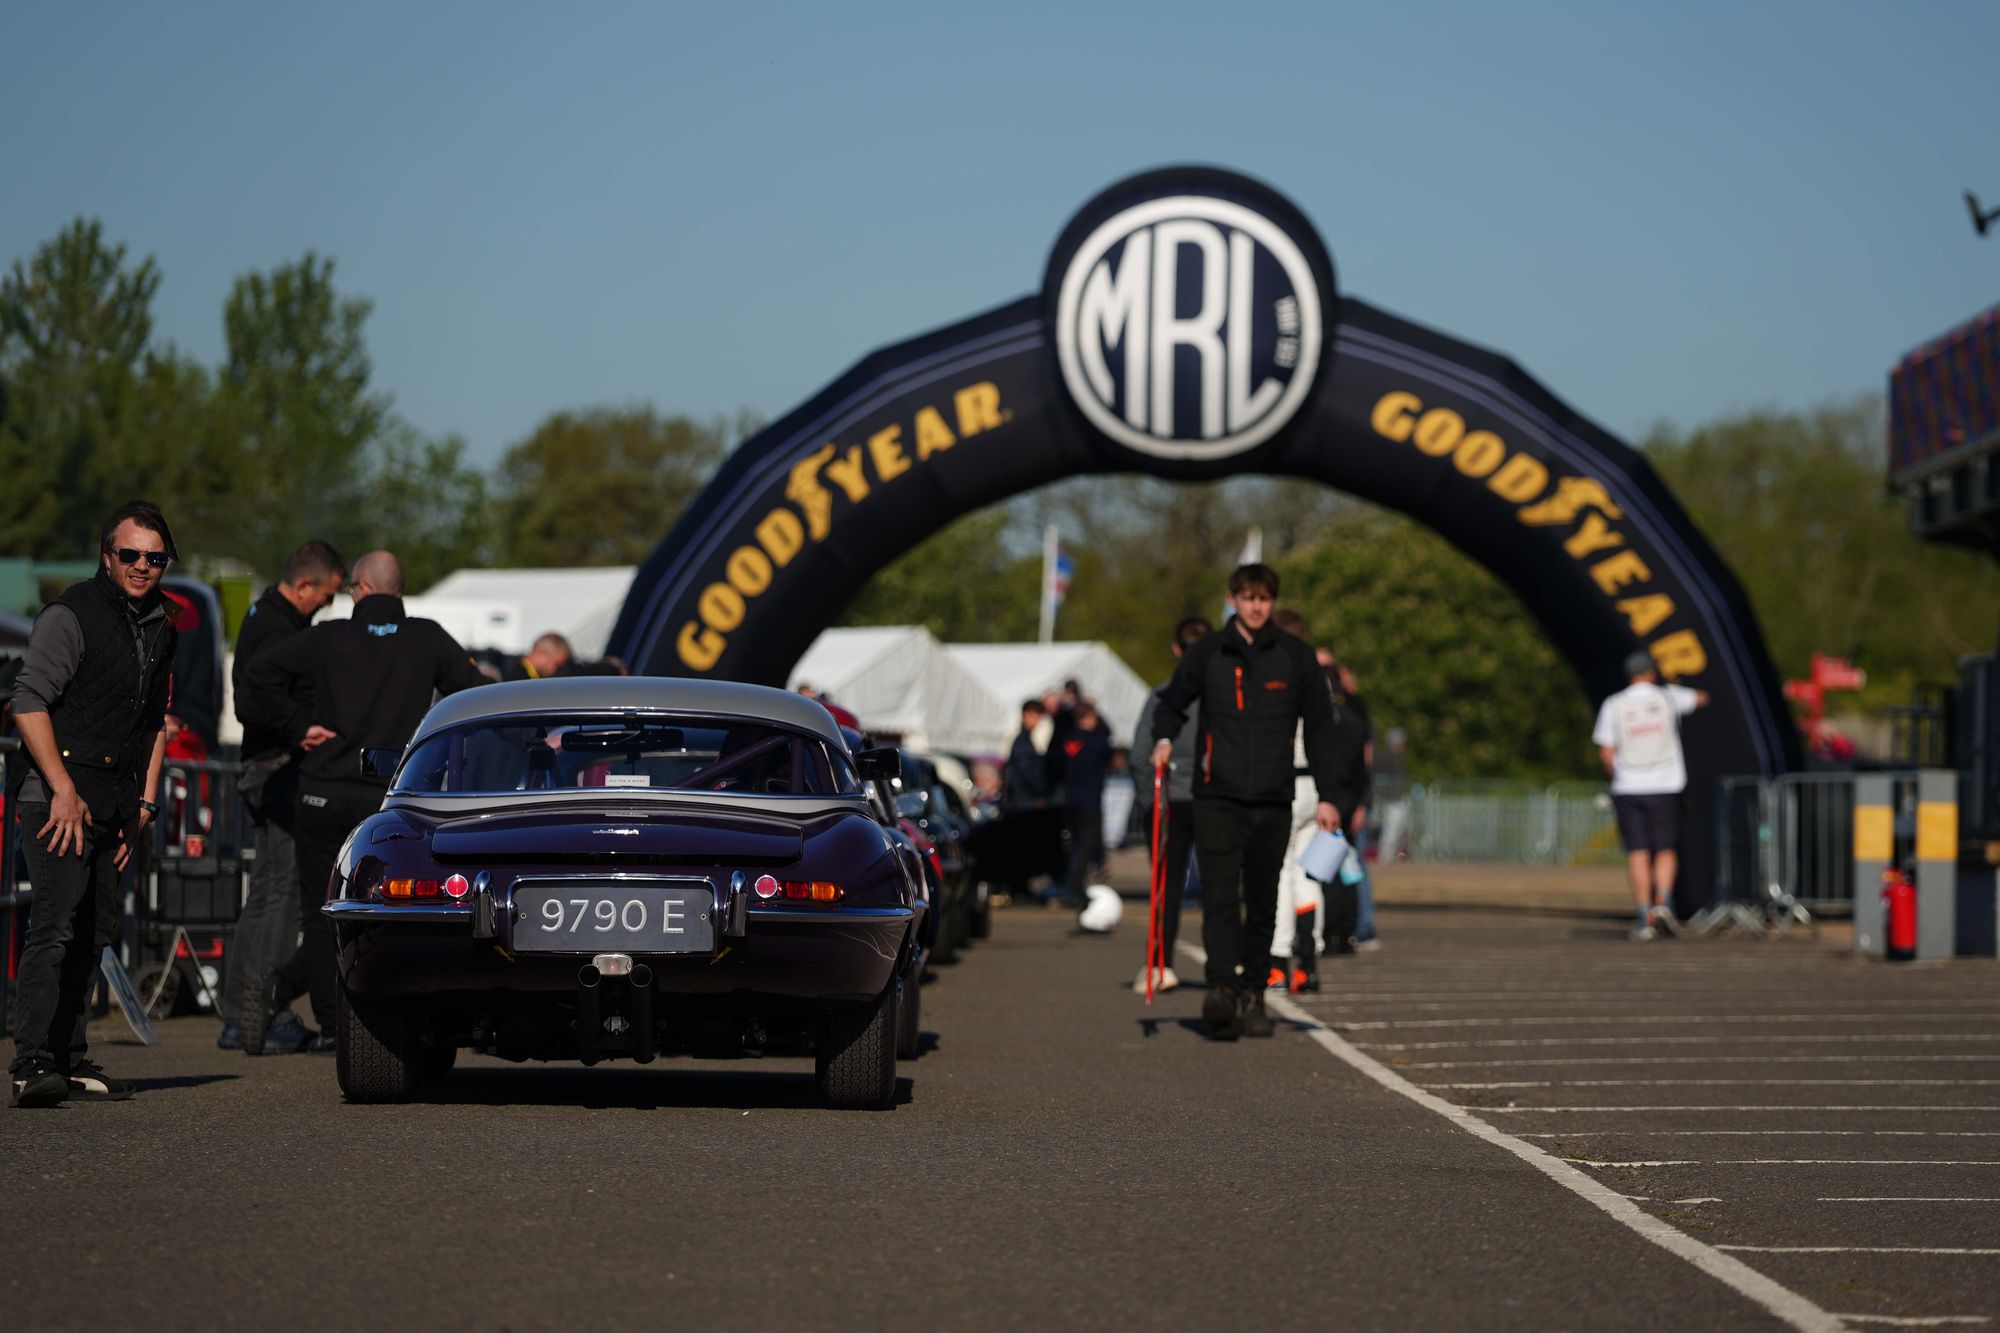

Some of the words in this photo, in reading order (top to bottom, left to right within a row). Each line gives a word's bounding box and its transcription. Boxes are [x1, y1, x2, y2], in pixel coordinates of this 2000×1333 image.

[1076, 217, 1286, 440] MRL
[675, 380, 1004, 672] GOODYEAR
[1370, 390, 1708, 683] GOODYEAR
[541, 898, 648, 933] 9790
[662, 899, 685, 934] E
